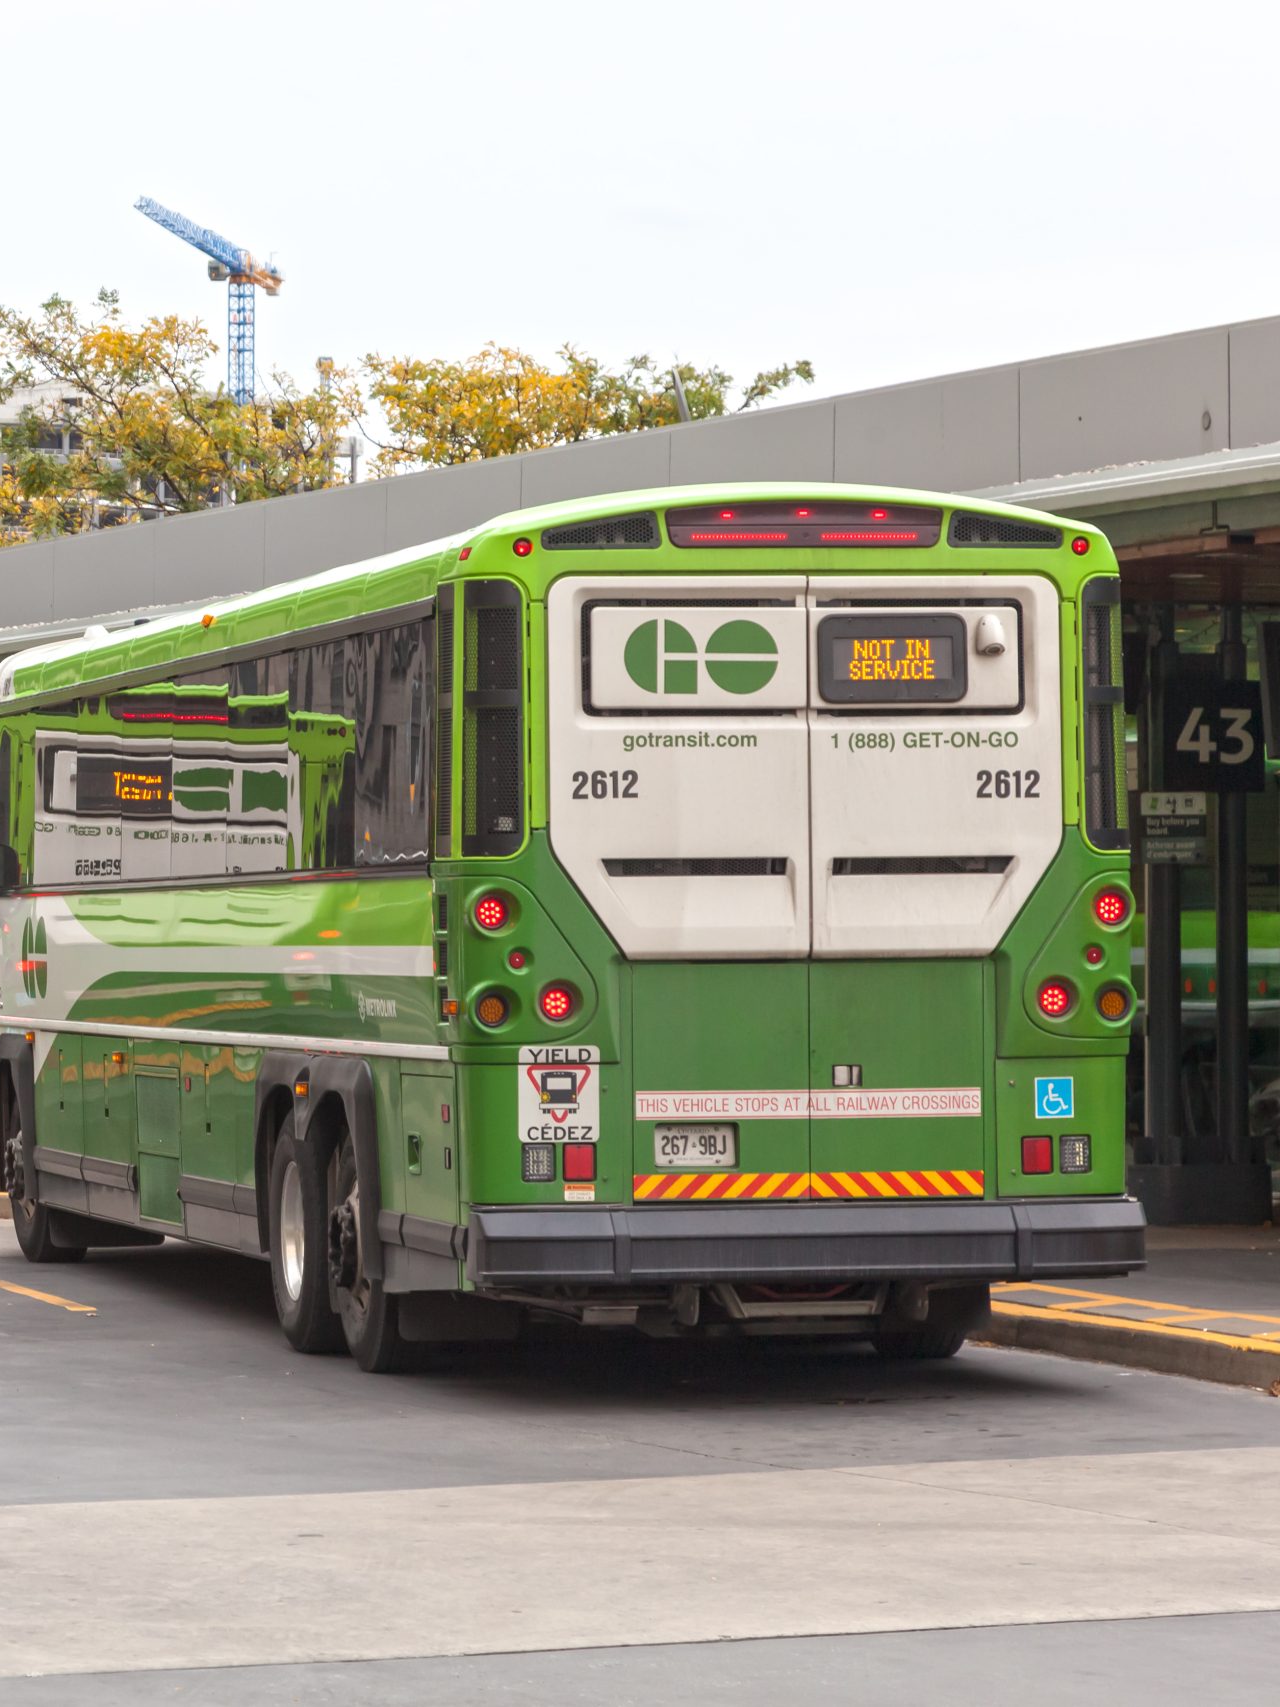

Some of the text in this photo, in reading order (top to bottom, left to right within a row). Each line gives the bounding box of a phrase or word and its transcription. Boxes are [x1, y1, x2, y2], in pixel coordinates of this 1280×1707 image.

[624, 618, 778, 694] GO
[854, 640, 930, 659] NOT IN
[849, 660, 934, 680] SERVICE
[622, 732, 758, 754] gotransit.com
[830, 732, 1019, 752] 1 (888) GET-ON-GO
[1176, 707, 1254, 765] 43
[572, 770, 638, 800] 2612
[976, 770, 1040, 798] 2612
[366, 998, 397, 1018] METROLINX
[528, 1048, 591, 1063] YIELD
[640, 1095, 980, 1112] THIS VEHICLE STOPS AT ALL RAILWAY CROSSINGS
[527, 1124, 593, 1141] CÉDEZ
[661, 1134, 727, 1156] 267 9BJ
